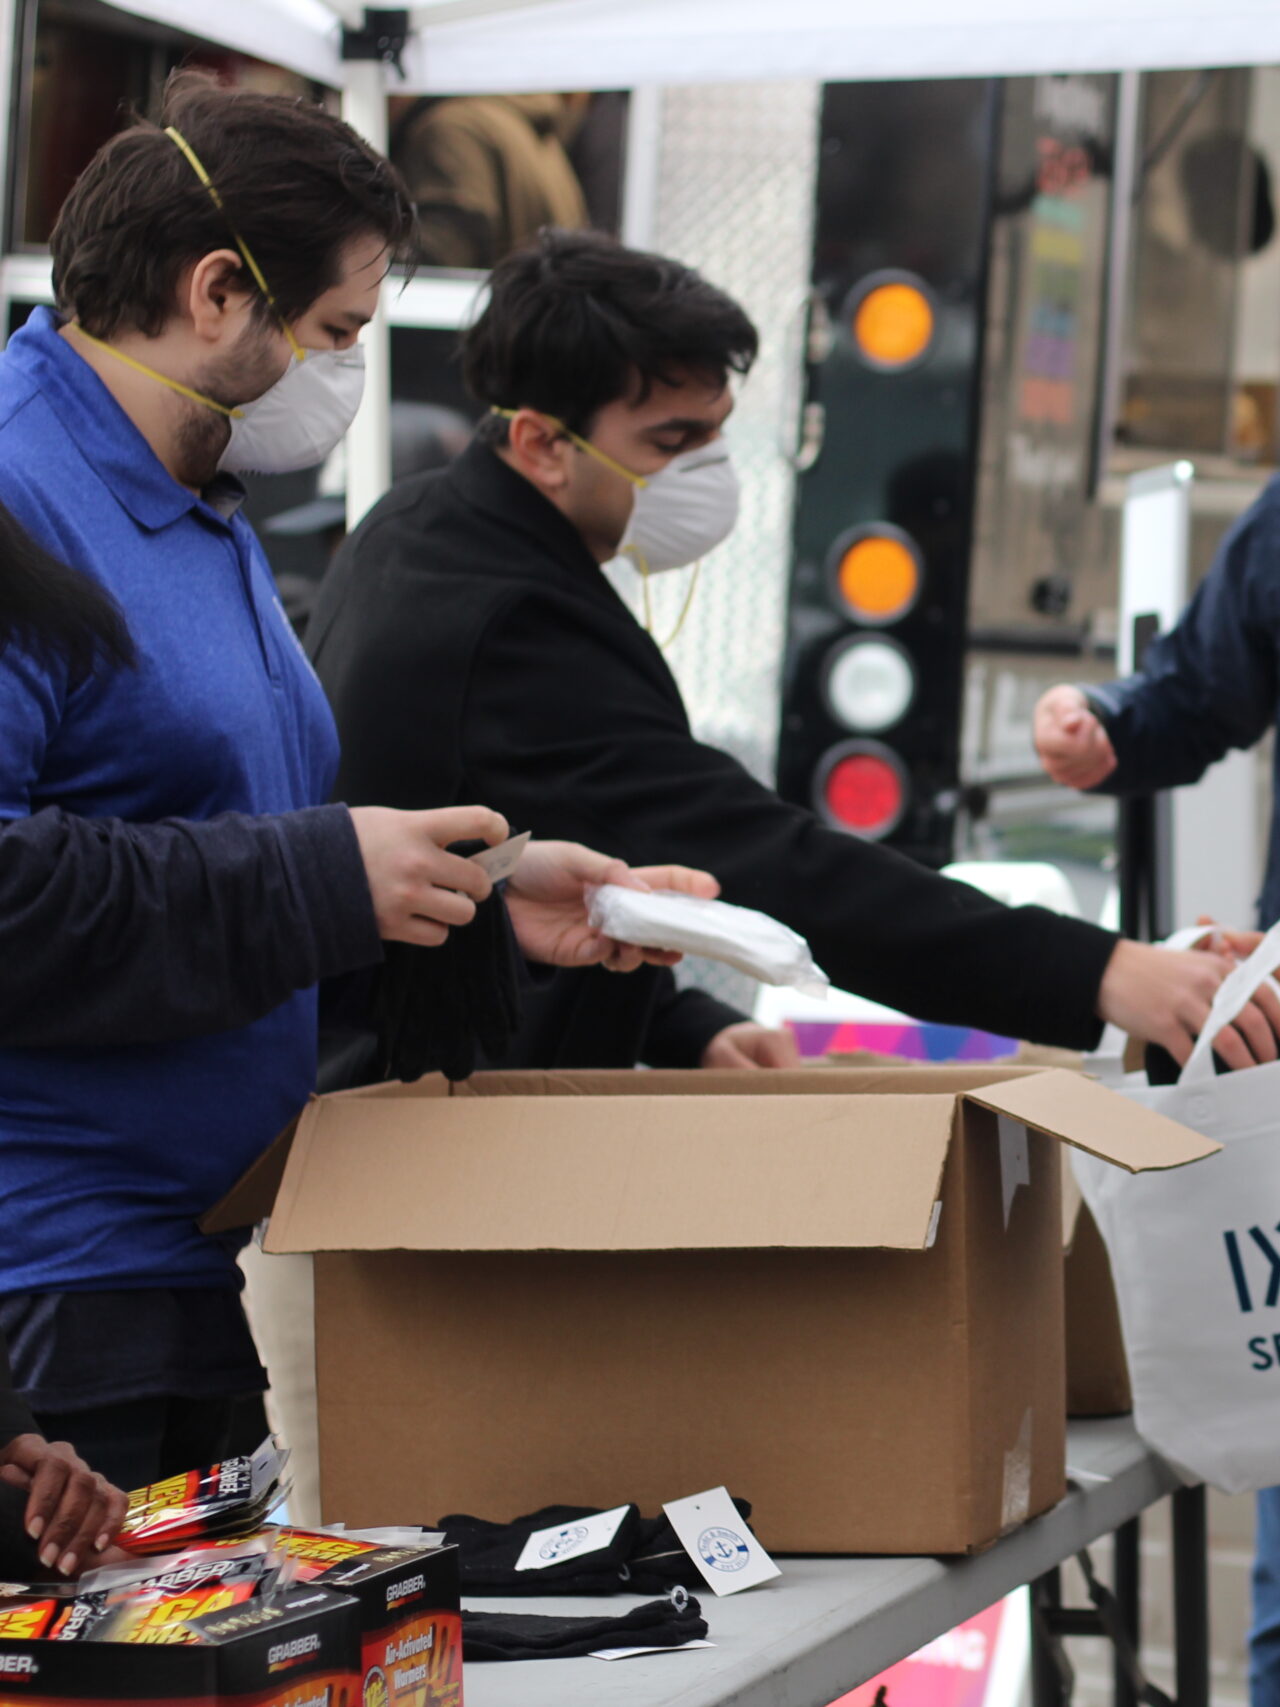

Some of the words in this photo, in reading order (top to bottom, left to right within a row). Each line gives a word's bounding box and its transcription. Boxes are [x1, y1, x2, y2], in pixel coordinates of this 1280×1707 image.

[386, 1574, 424, 1602] GRABBER
[268, 1633, 319, 1664] GRABBER
[385, 1625, 433, 1666] Air-Activated
